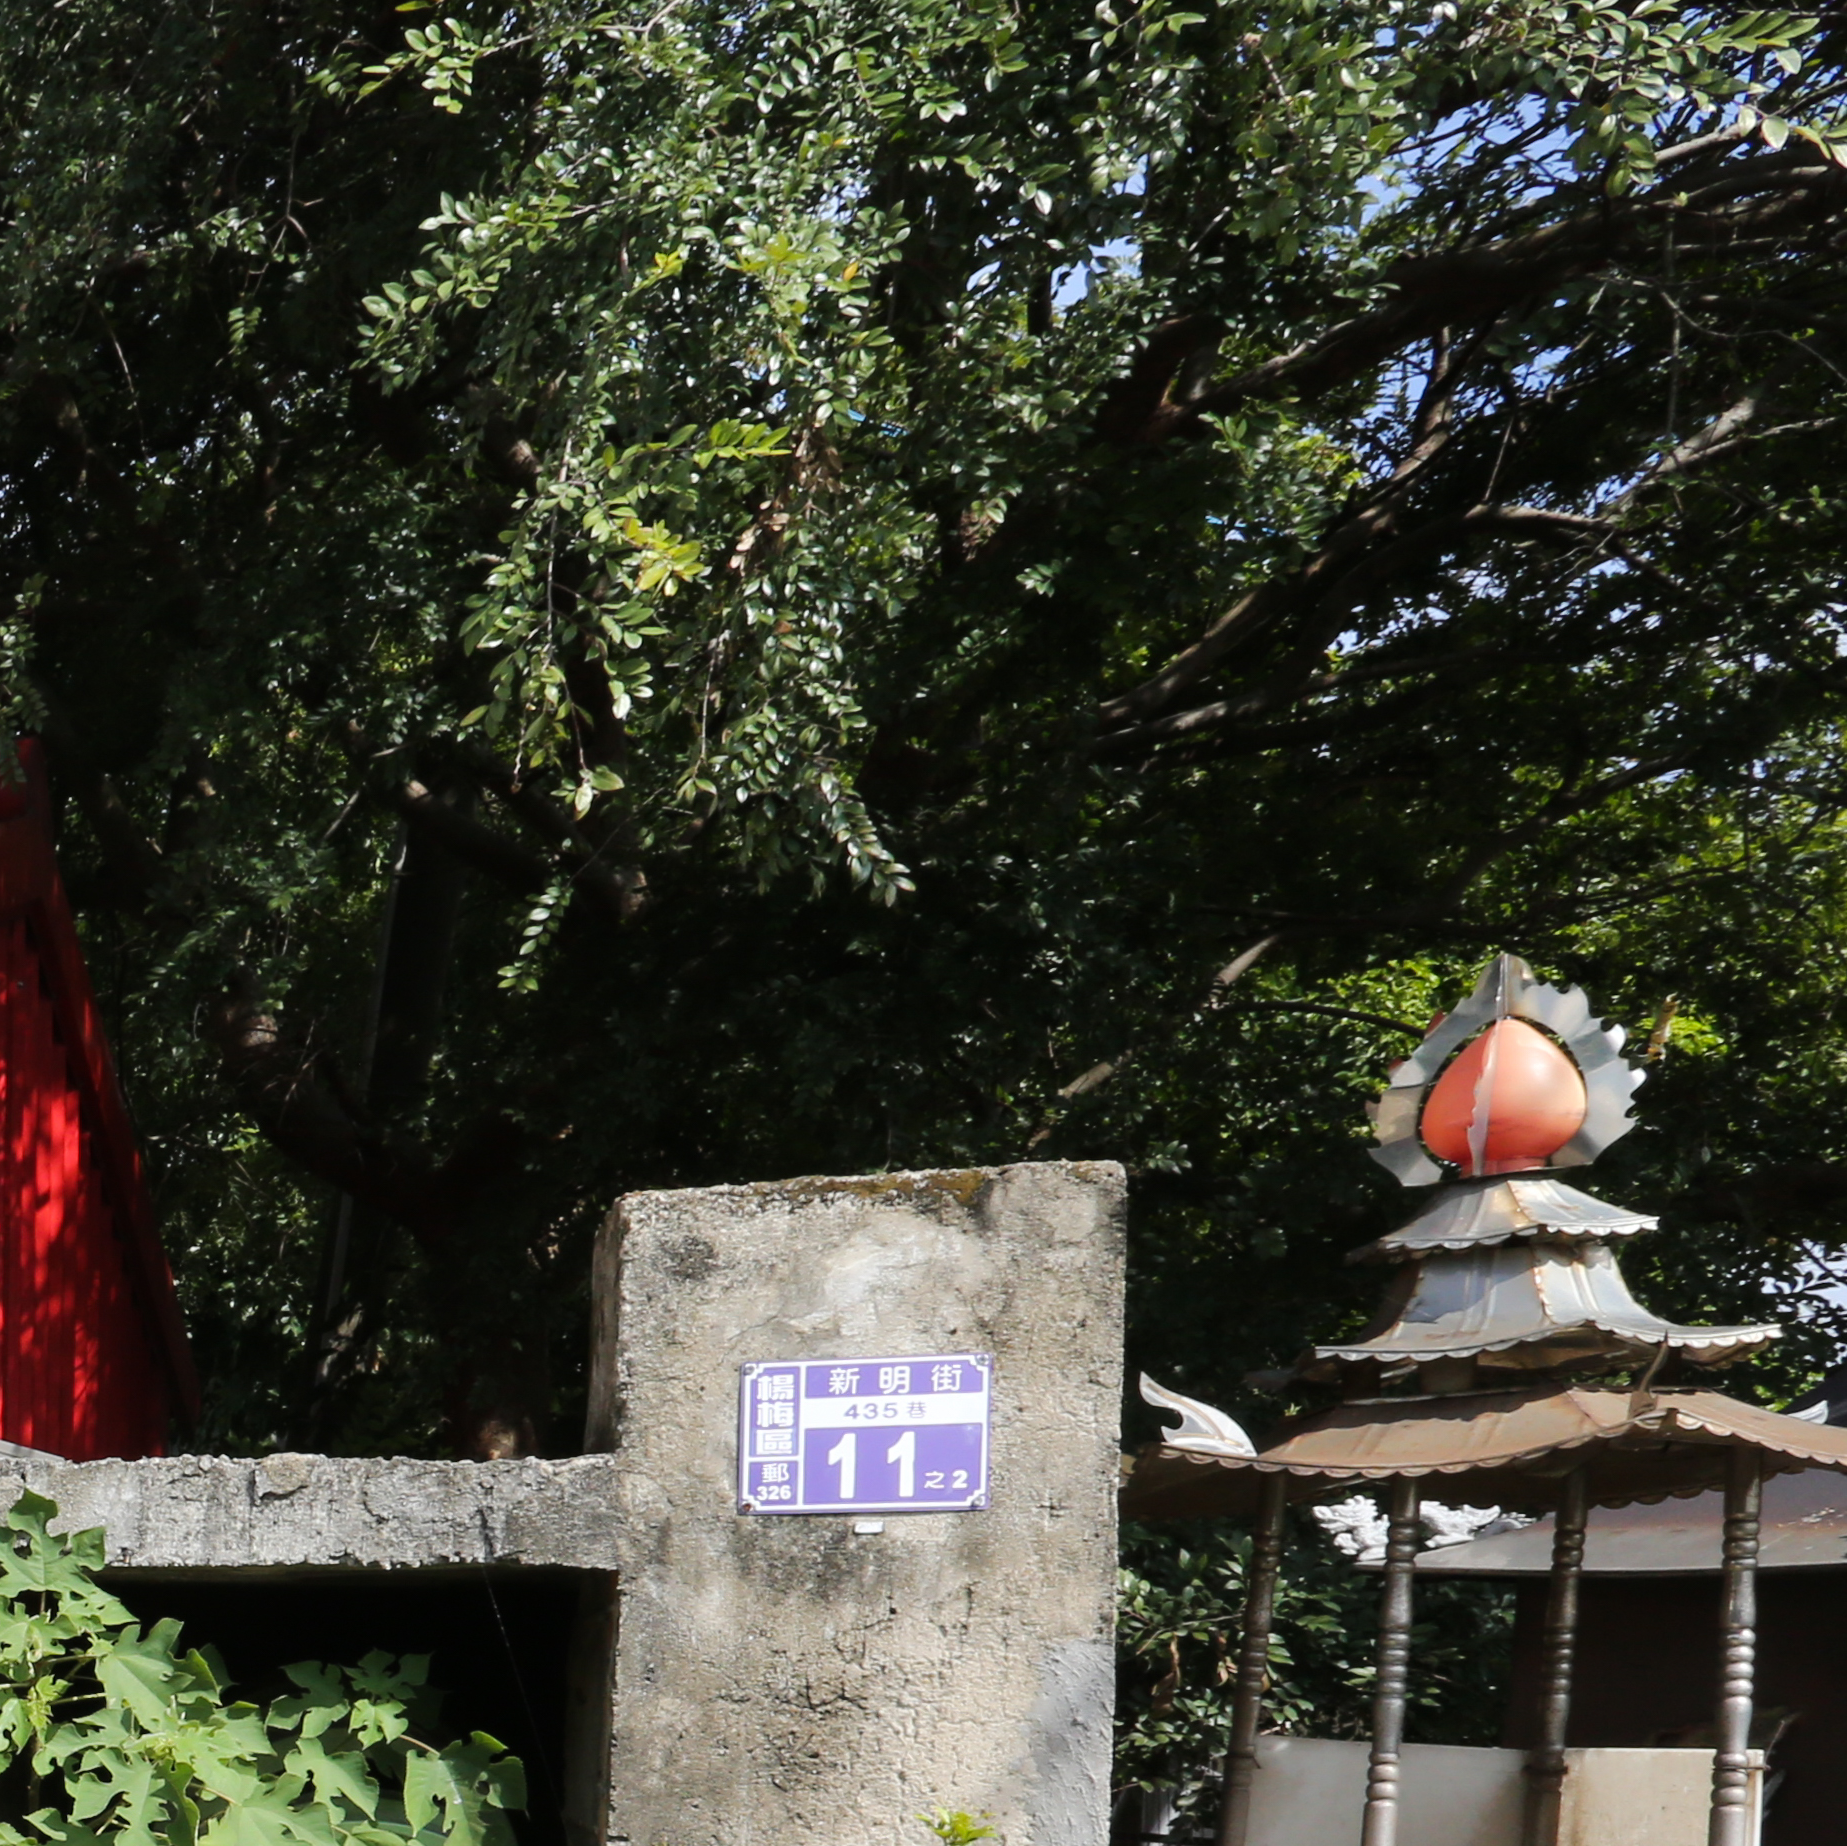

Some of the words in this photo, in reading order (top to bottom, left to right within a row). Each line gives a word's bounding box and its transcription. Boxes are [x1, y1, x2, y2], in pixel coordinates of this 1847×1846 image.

[828, 1364, 962, 1395] 新明街
[756, 1374, 795, 1455] 楊梅區
[761, 1463, 789, 1483] 郵
[828, 1431, 916, 1499] 11
[757, 1486, 791, 1500] 326
